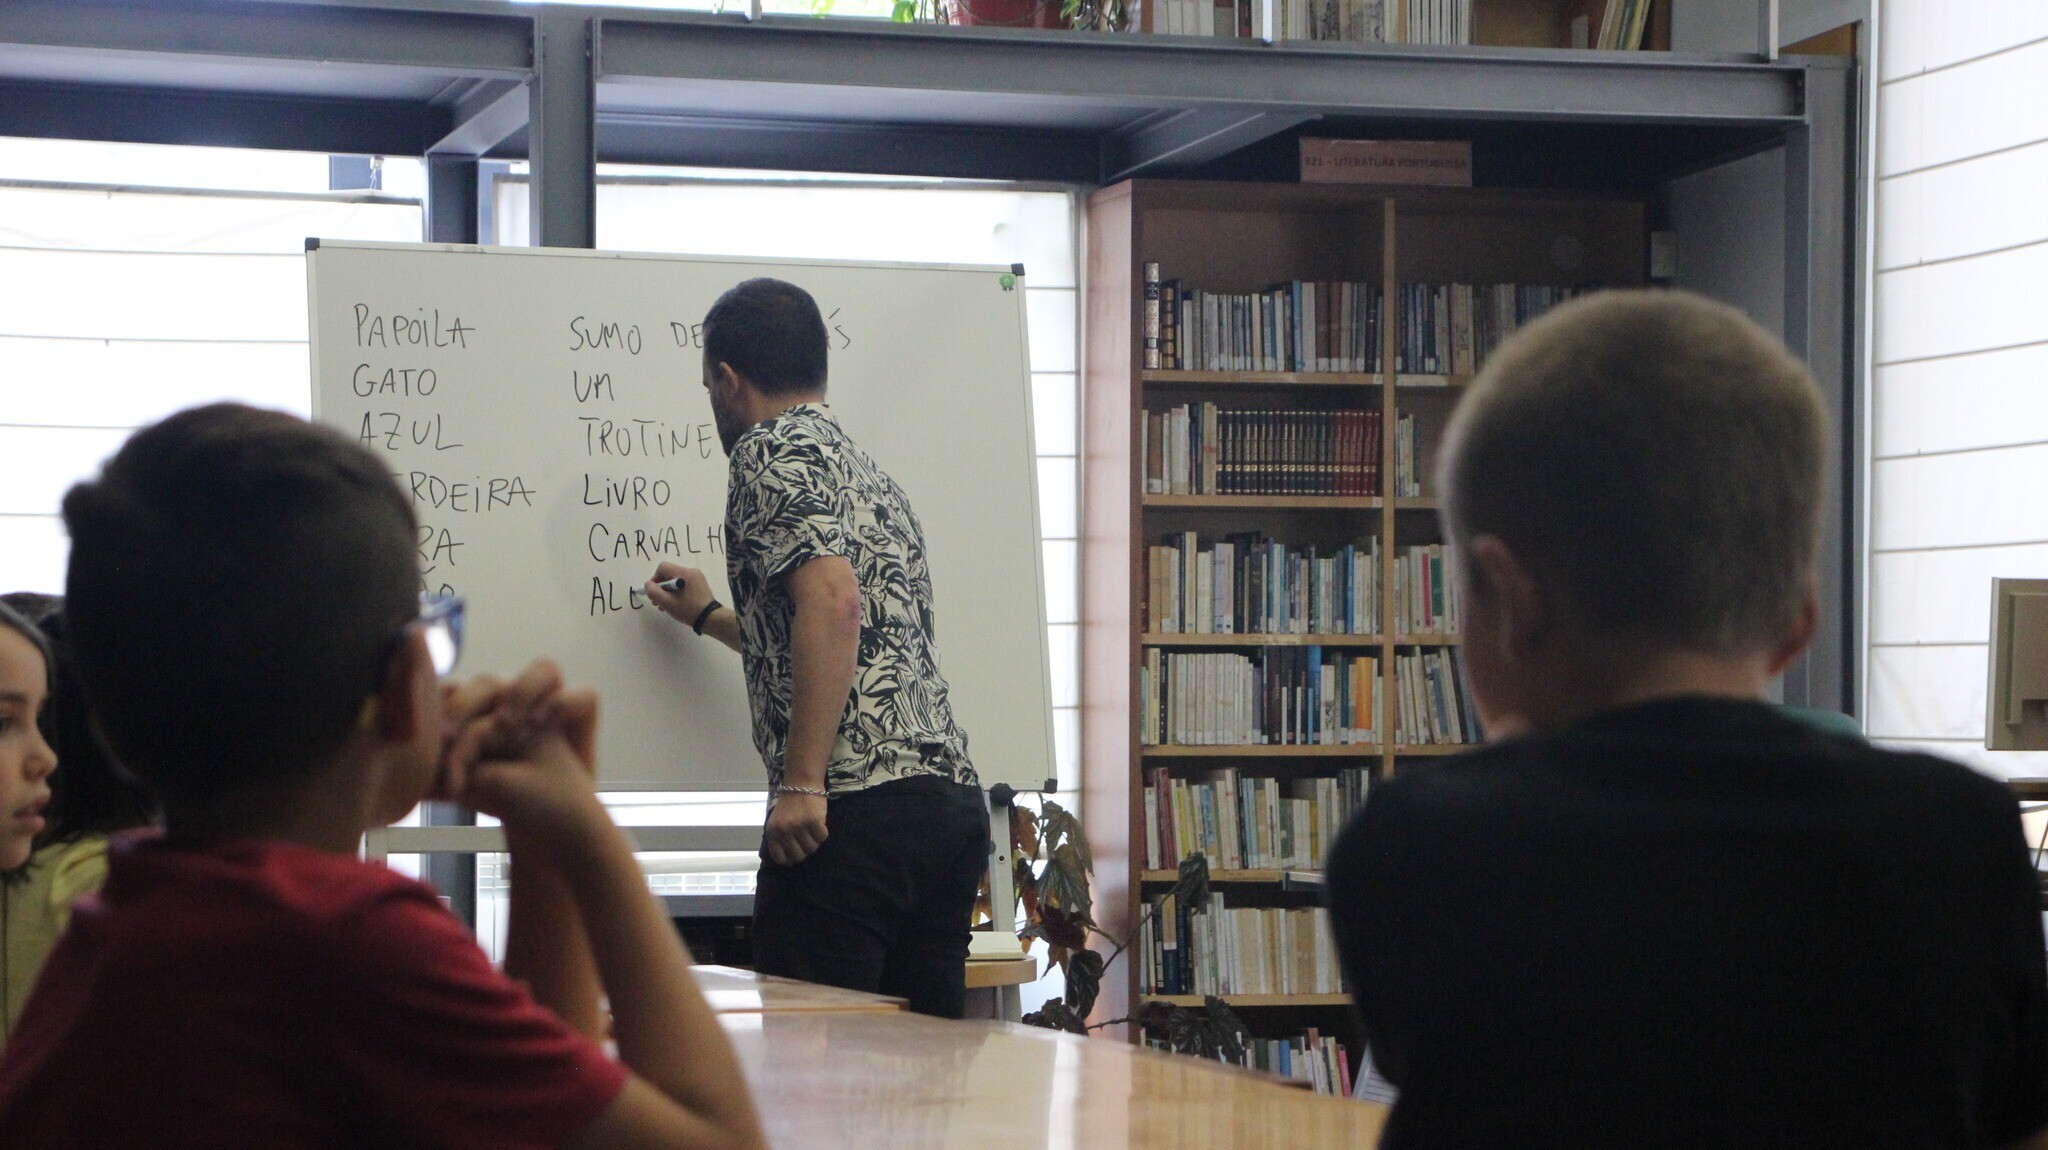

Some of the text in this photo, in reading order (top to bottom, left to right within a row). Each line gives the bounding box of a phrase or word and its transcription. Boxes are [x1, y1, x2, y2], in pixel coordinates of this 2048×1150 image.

[1334, 157, 1395, 168] LITERATURA
[569, 315, 642, 355] SUMO
[352, 363, 437, 397] GATO
[573, 370, 615, 403] UM
[359, 411, 464, 451] AZUL
[578, 416, 713, 460] TROTINE
[588, 523, 724, 563] CARVALH
